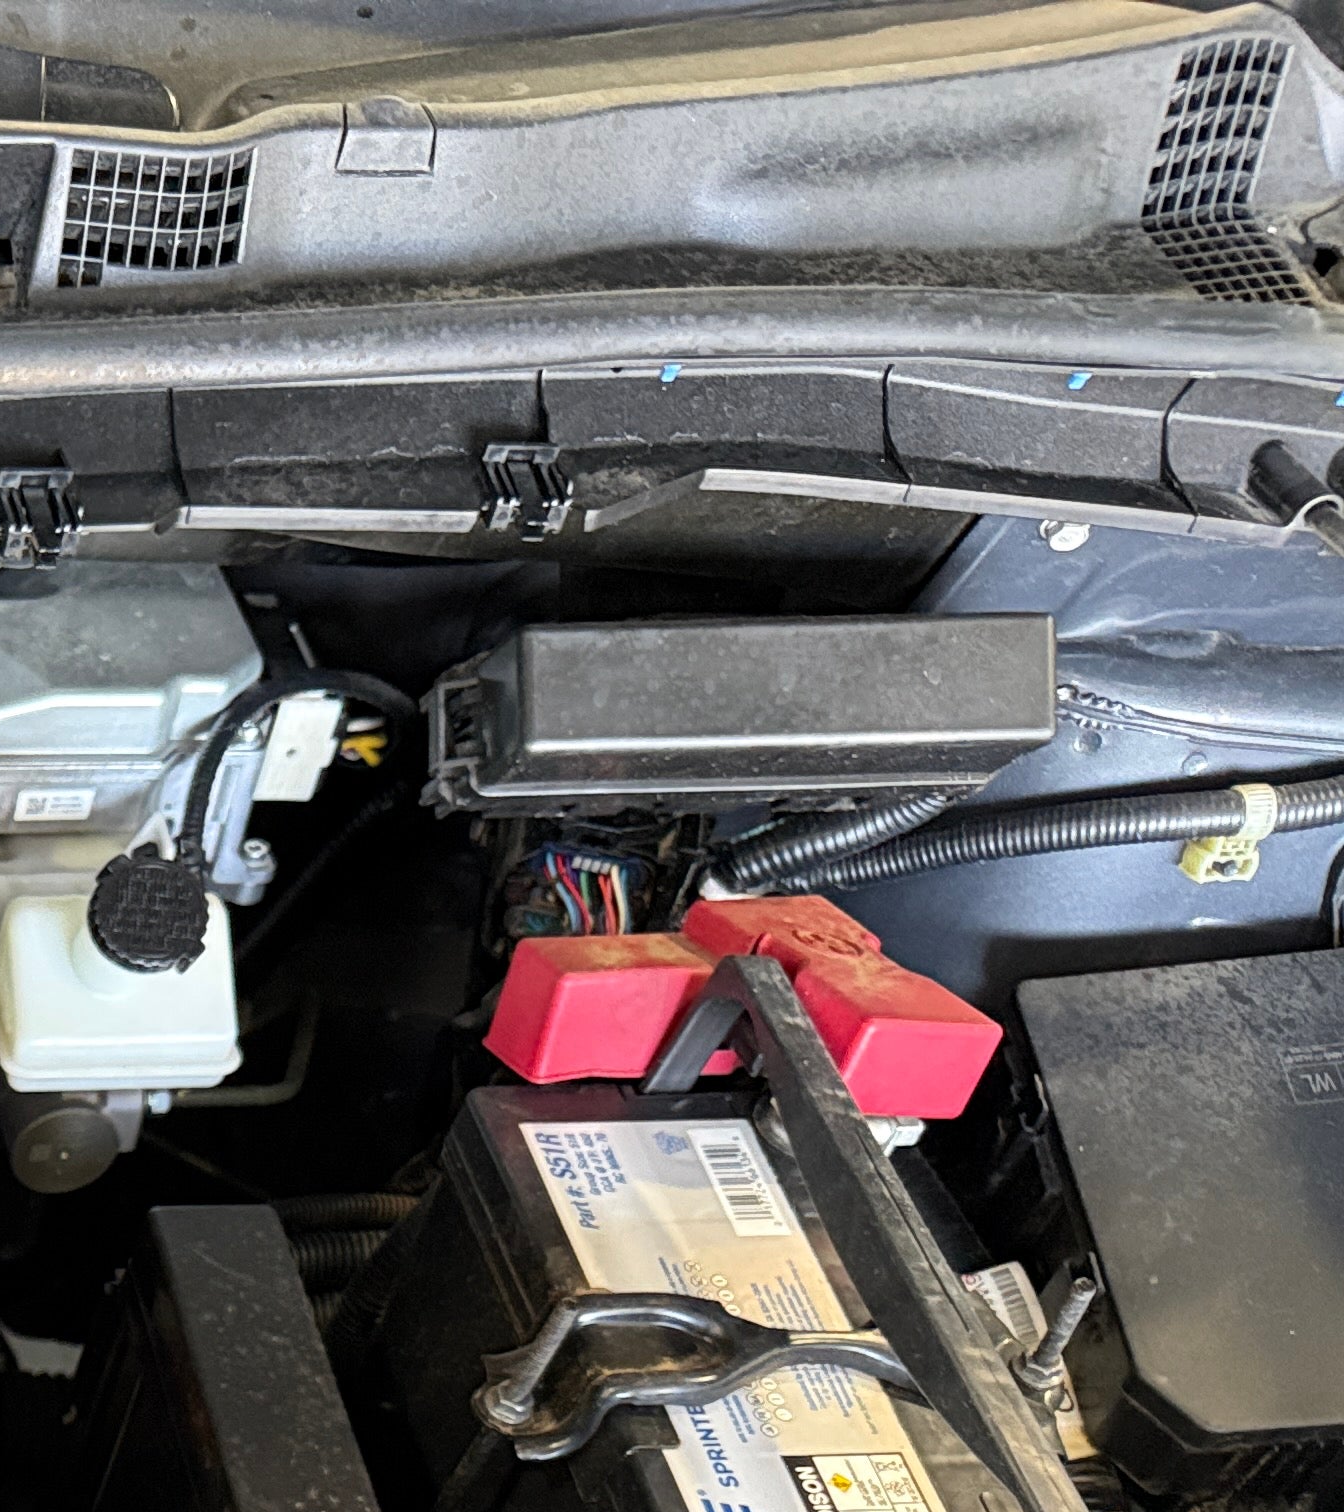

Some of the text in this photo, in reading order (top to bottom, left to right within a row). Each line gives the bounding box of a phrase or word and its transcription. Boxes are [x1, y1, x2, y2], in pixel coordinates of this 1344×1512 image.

[534, 1133, 577, 1180] S51R
[570, 1201, 600, 1230] Part
[686, 1403, 740, 1488] SPRINTE
